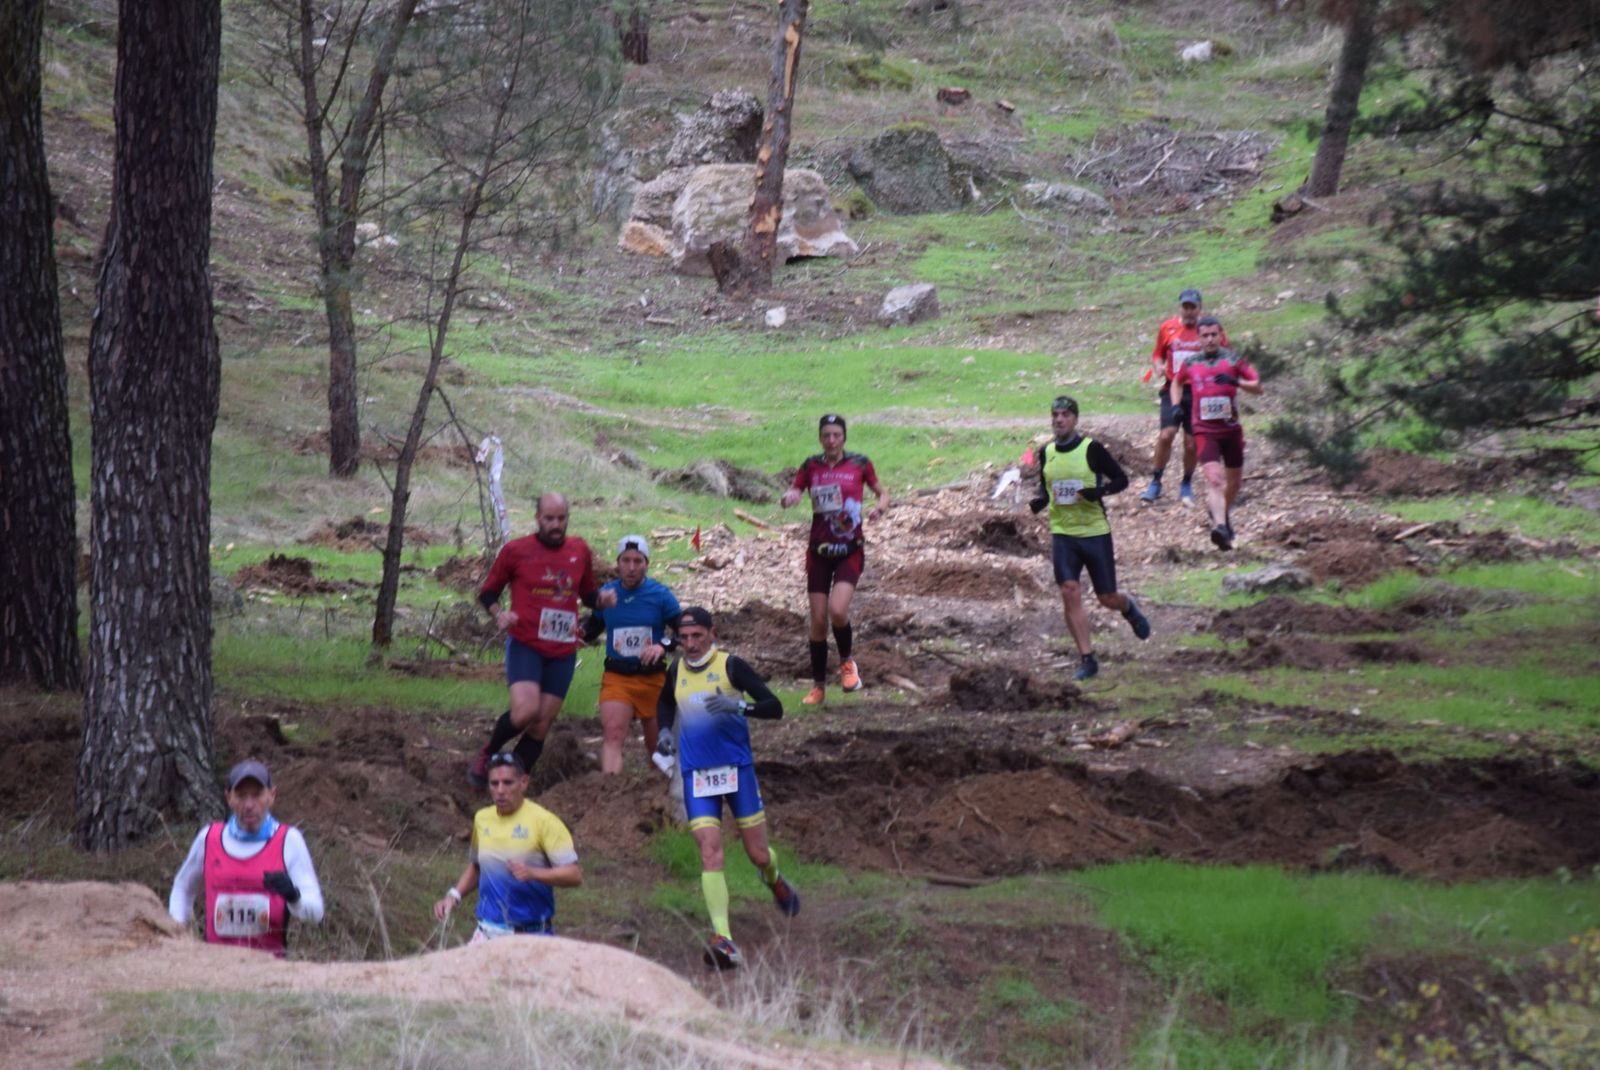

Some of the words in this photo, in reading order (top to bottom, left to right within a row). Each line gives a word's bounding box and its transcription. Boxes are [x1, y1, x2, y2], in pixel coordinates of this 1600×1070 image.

[625, 636, 640, 647] 62
[705, 774, 727, 787] 185
[227, 908, 255, 923] 115
